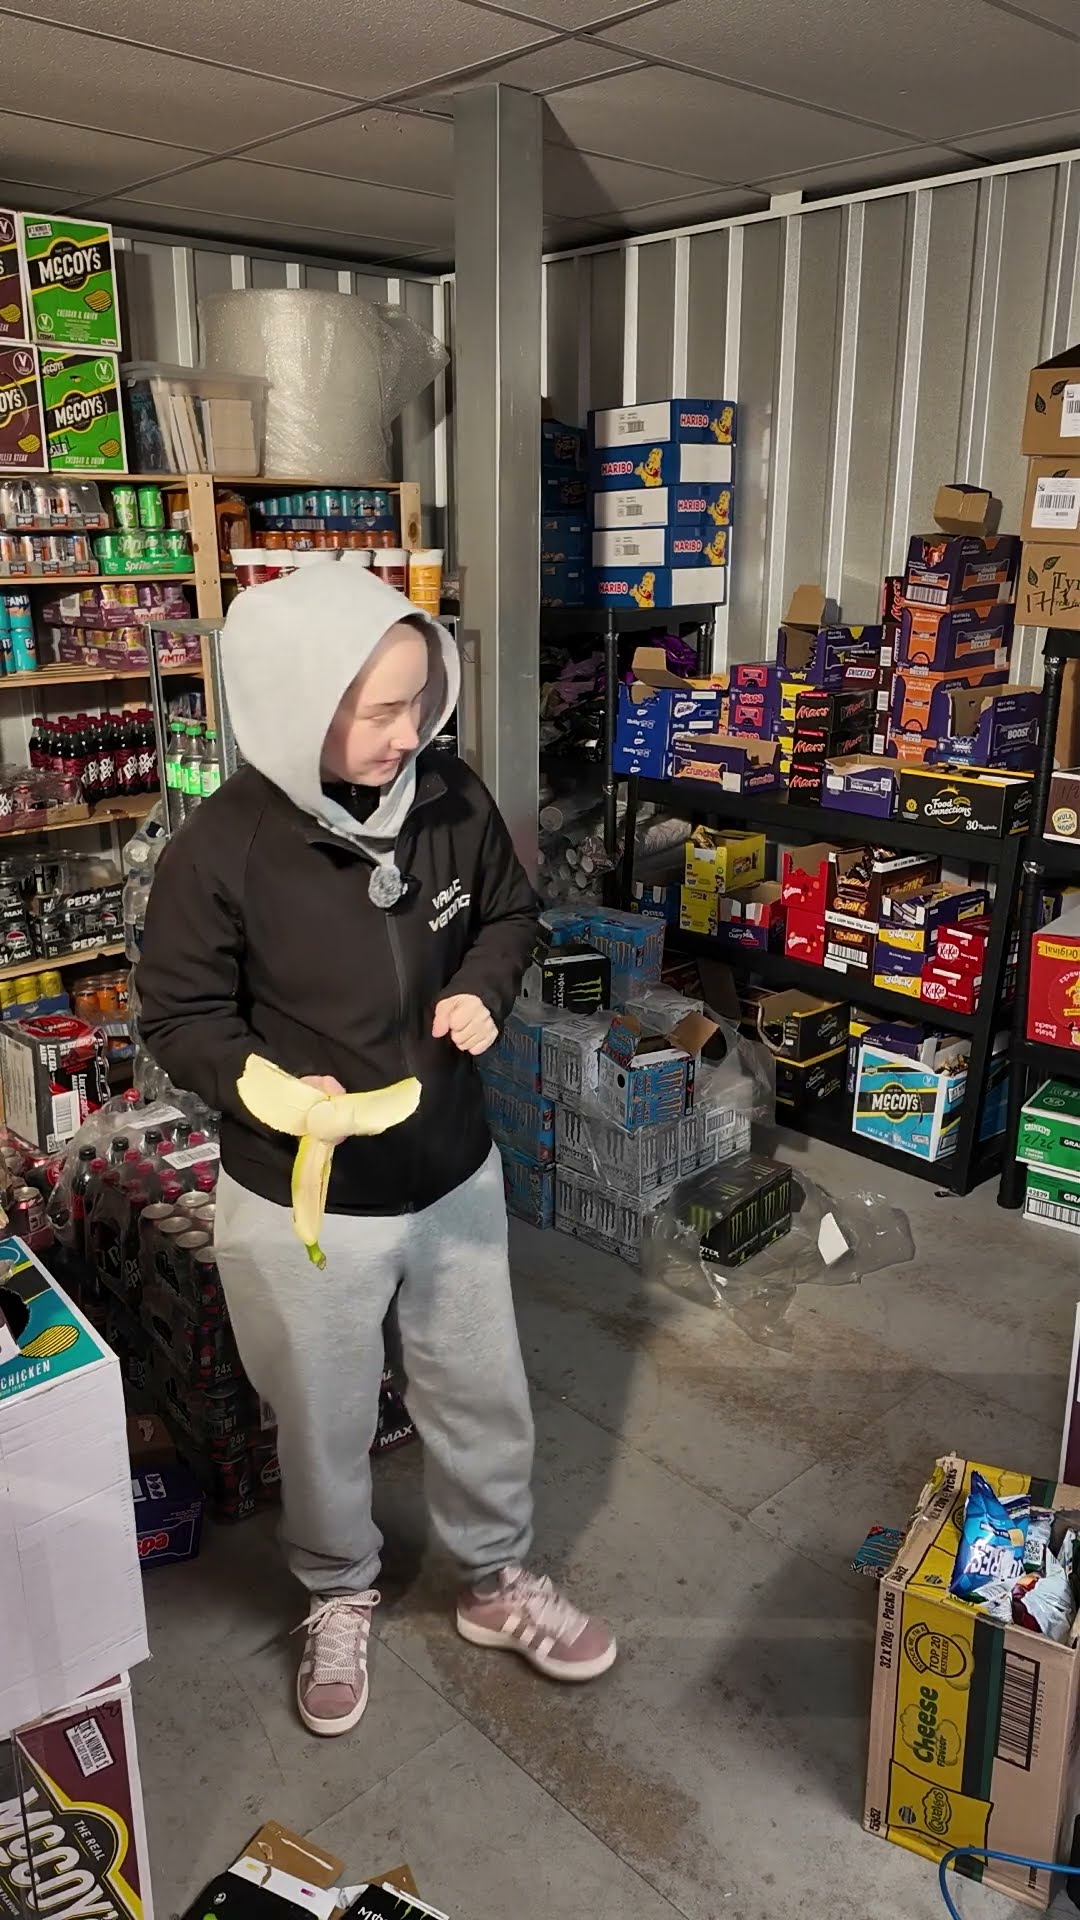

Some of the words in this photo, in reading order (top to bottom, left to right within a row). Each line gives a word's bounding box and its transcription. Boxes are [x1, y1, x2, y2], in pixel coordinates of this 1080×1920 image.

[680, 414, 708, 427] HARIBO
[602, 461, 633, 474] HARIBO
[677, 500, 706, 512] HARIBO
[674, 540, 702, 552] HARIBO
[599, 583, 628, 594] HARIBO
[971, 639, 991, 650] DECKER
[848, 667, 874, 678] SNICKERS
[739, 693, 764, 704] wispa
[796, 705, 829, 719] Mars
[1007, 728, 1030, 740] BOOST
[794, 740, 825, 753] Mars
[686, 767, 720, 779] crunchie
[790, 775, 820, 788] Mars
[924, 804, 972, 817] Connections
[932, 798, 953, 809] Food
[966, 820, 978, 831] 30
[67, 893, 100, 907] PEPSI
[105, 890, 121, 898] MAX
[4, 909, 23, 918] MAX
[72, 935, 107, 950] PEPSI
[14, 950, 31, 959] MAX
[940, 944, 958, 959] KitKat
[1046, 945, 1078, 959] Original
[1059, 970, 1080, 984] nacks
[926, 984, 945, 998] KitKat
[1035, 1028, 1056, 1039] Potato
[1064, 1139, 1080, 1149] GRA
[1064, 1192, 1080, 1203] GRA
[1, 1359, 50, 1390] CHICKEN
[215, 1363, 232, 1378] 24x
[230, 1433, 245, 1448] 24x
[380, 1424, 413, 1447] MAX
[883, 1591, 896, 1621] Packs
[881, 1630, 895, 1649] 20g
[931, 1635, 941, 1649] 20
[880, 1655, 891, 1669] 32
[908, 1644, 923, 1670] STOCK
[929, 1648, 940, 1669] TOP
[940, 1638, 949, 1674] BESTSELLER
[913, 1685, 939, 1763] Cheese
[85, 1735, 107, 1764] NUMBER
[937, 1735, 948, 1767] Flavour
[74, 1820, 91, 1838] THE
[86, 1838, 105, 1861] REAL
